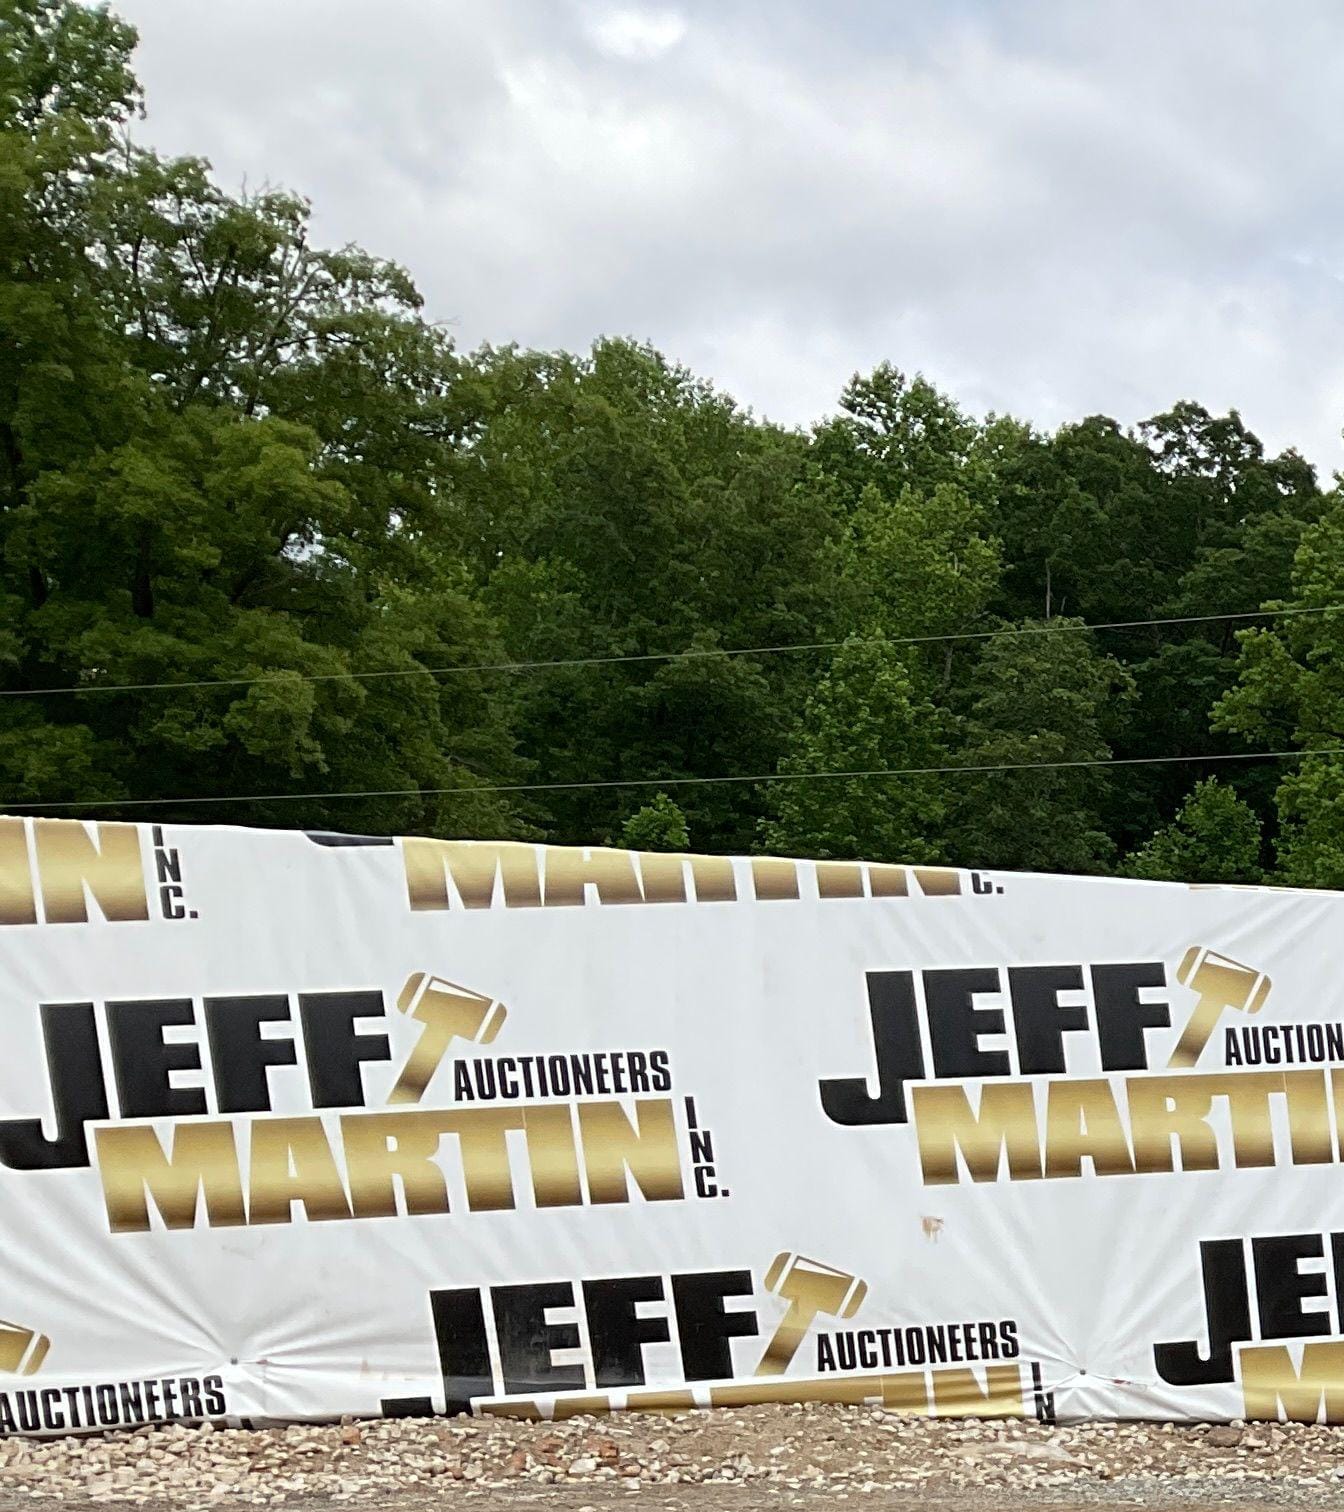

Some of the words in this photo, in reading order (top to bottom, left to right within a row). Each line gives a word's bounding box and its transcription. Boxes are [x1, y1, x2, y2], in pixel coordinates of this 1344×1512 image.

[0, 990, 392, 1170] JEFF
[453, 1051, 671, 1101] AUCTIONEERS
[819, 962, 1171, 1126] JEFF
[94, 1098, 685, 1233] MARTIN
[685, 1096, 730, 1199] INC.
[380, 1269, 759, 1418] JEFF
[817, 1320, 1019, 1372] AUCTIONEERS
[0, 1375, 226, 1434] AUCTIONEERS
